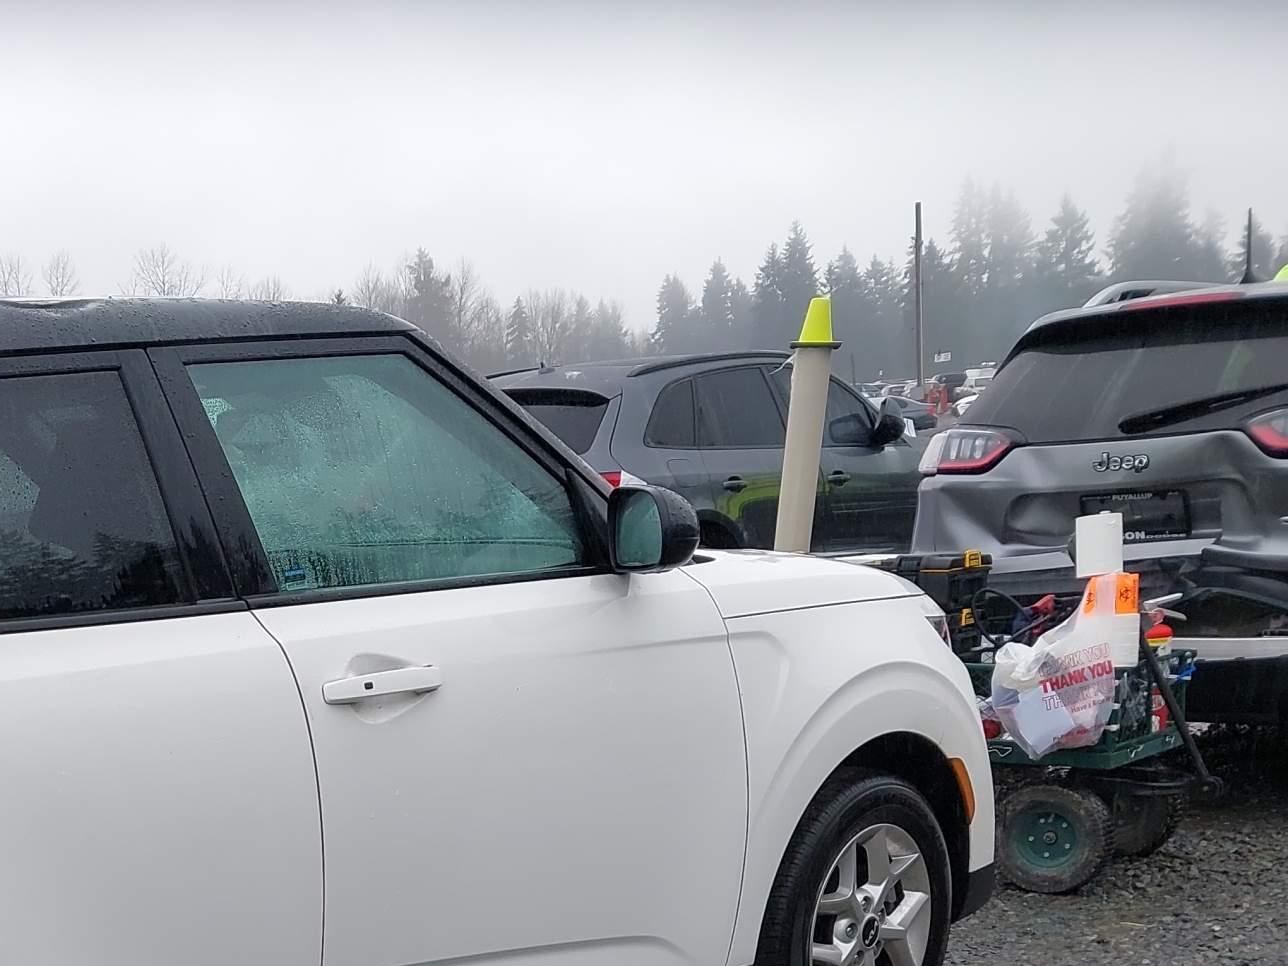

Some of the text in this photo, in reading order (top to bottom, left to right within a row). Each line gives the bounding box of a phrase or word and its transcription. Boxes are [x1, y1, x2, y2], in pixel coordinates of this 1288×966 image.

[1093, 452, 1150, 473] Jeep
[1083, 642, 1110, 662] YOU
[1039, 669, 1088, 694] THANK
[1087, 659, 1113, 679] YOU
